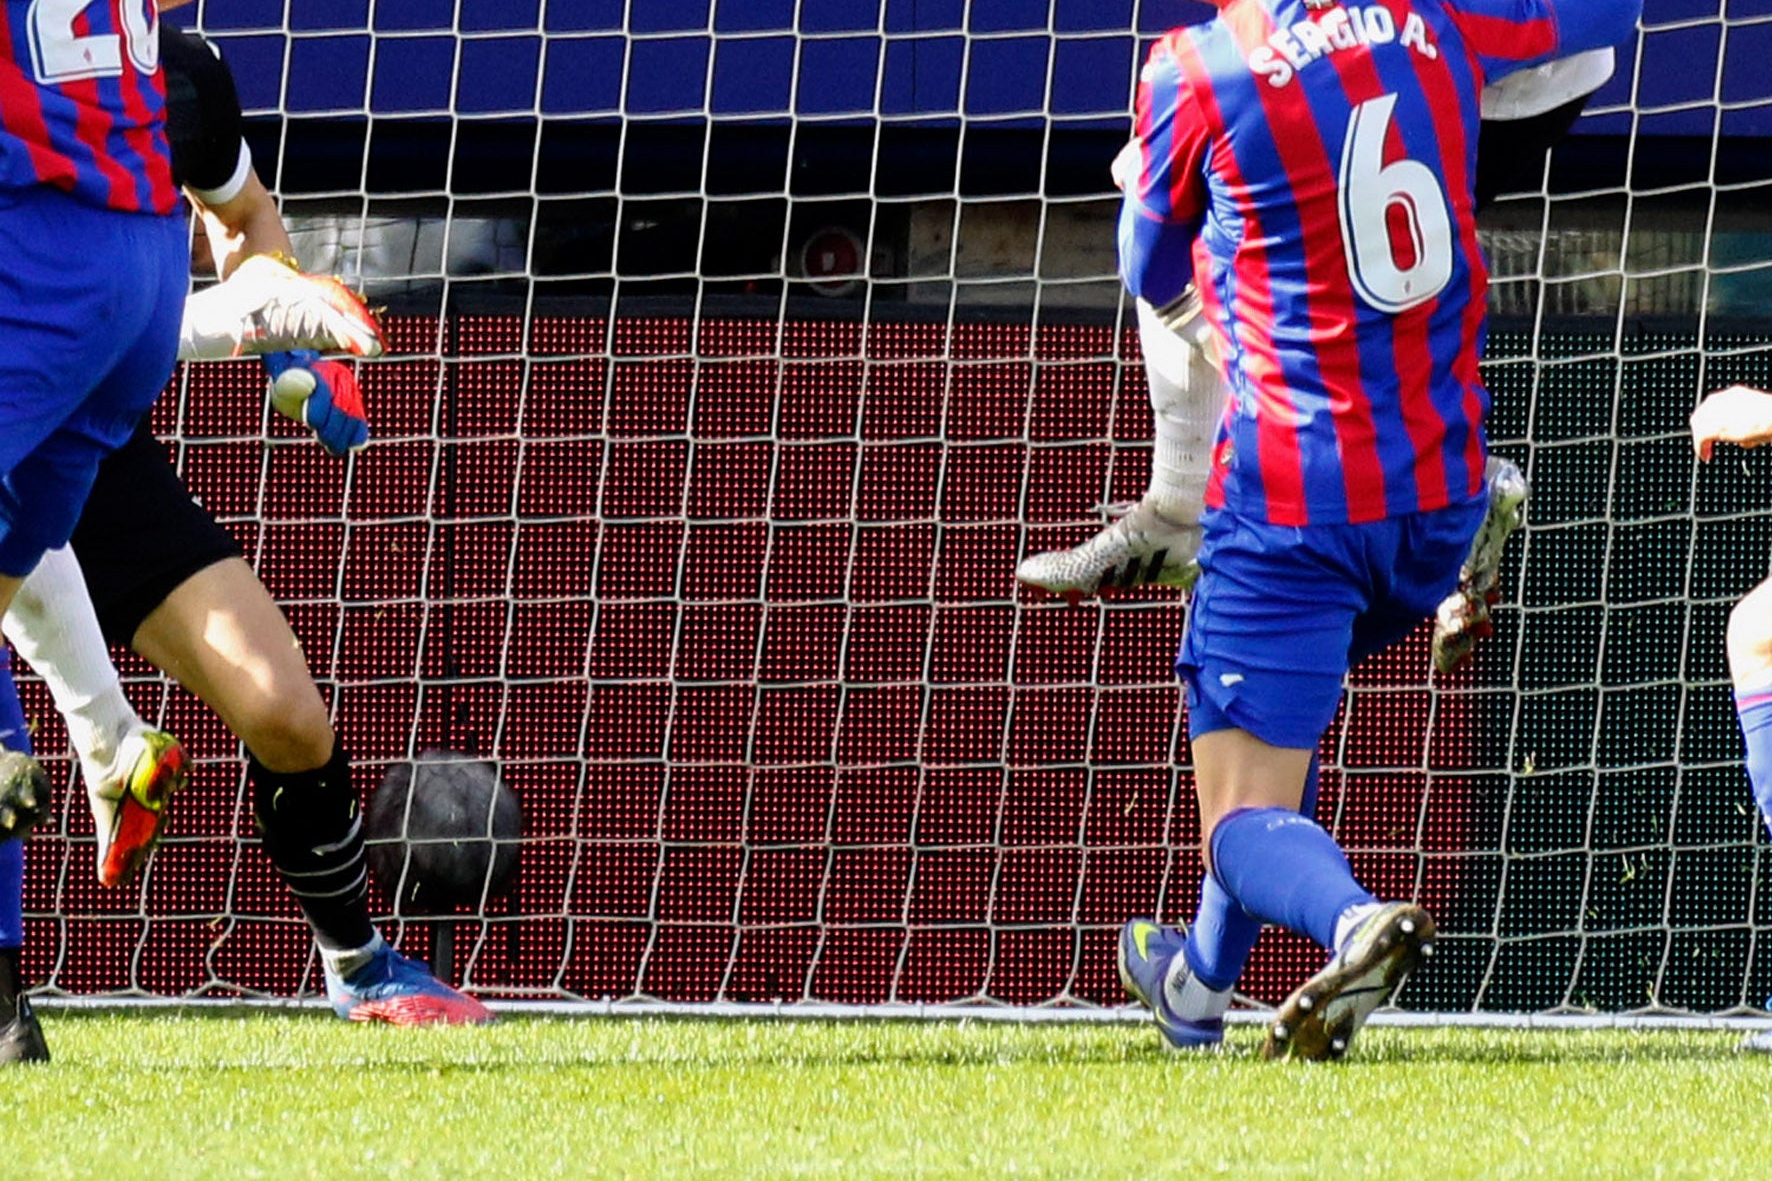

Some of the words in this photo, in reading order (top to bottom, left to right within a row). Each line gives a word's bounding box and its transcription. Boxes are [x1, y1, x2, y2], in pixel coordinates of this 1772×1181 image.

[1249, 5, 1395, 88] SERGIO
[1399, 12, 1438, 60] A.
[1338, 91, 1453, 314] 6
